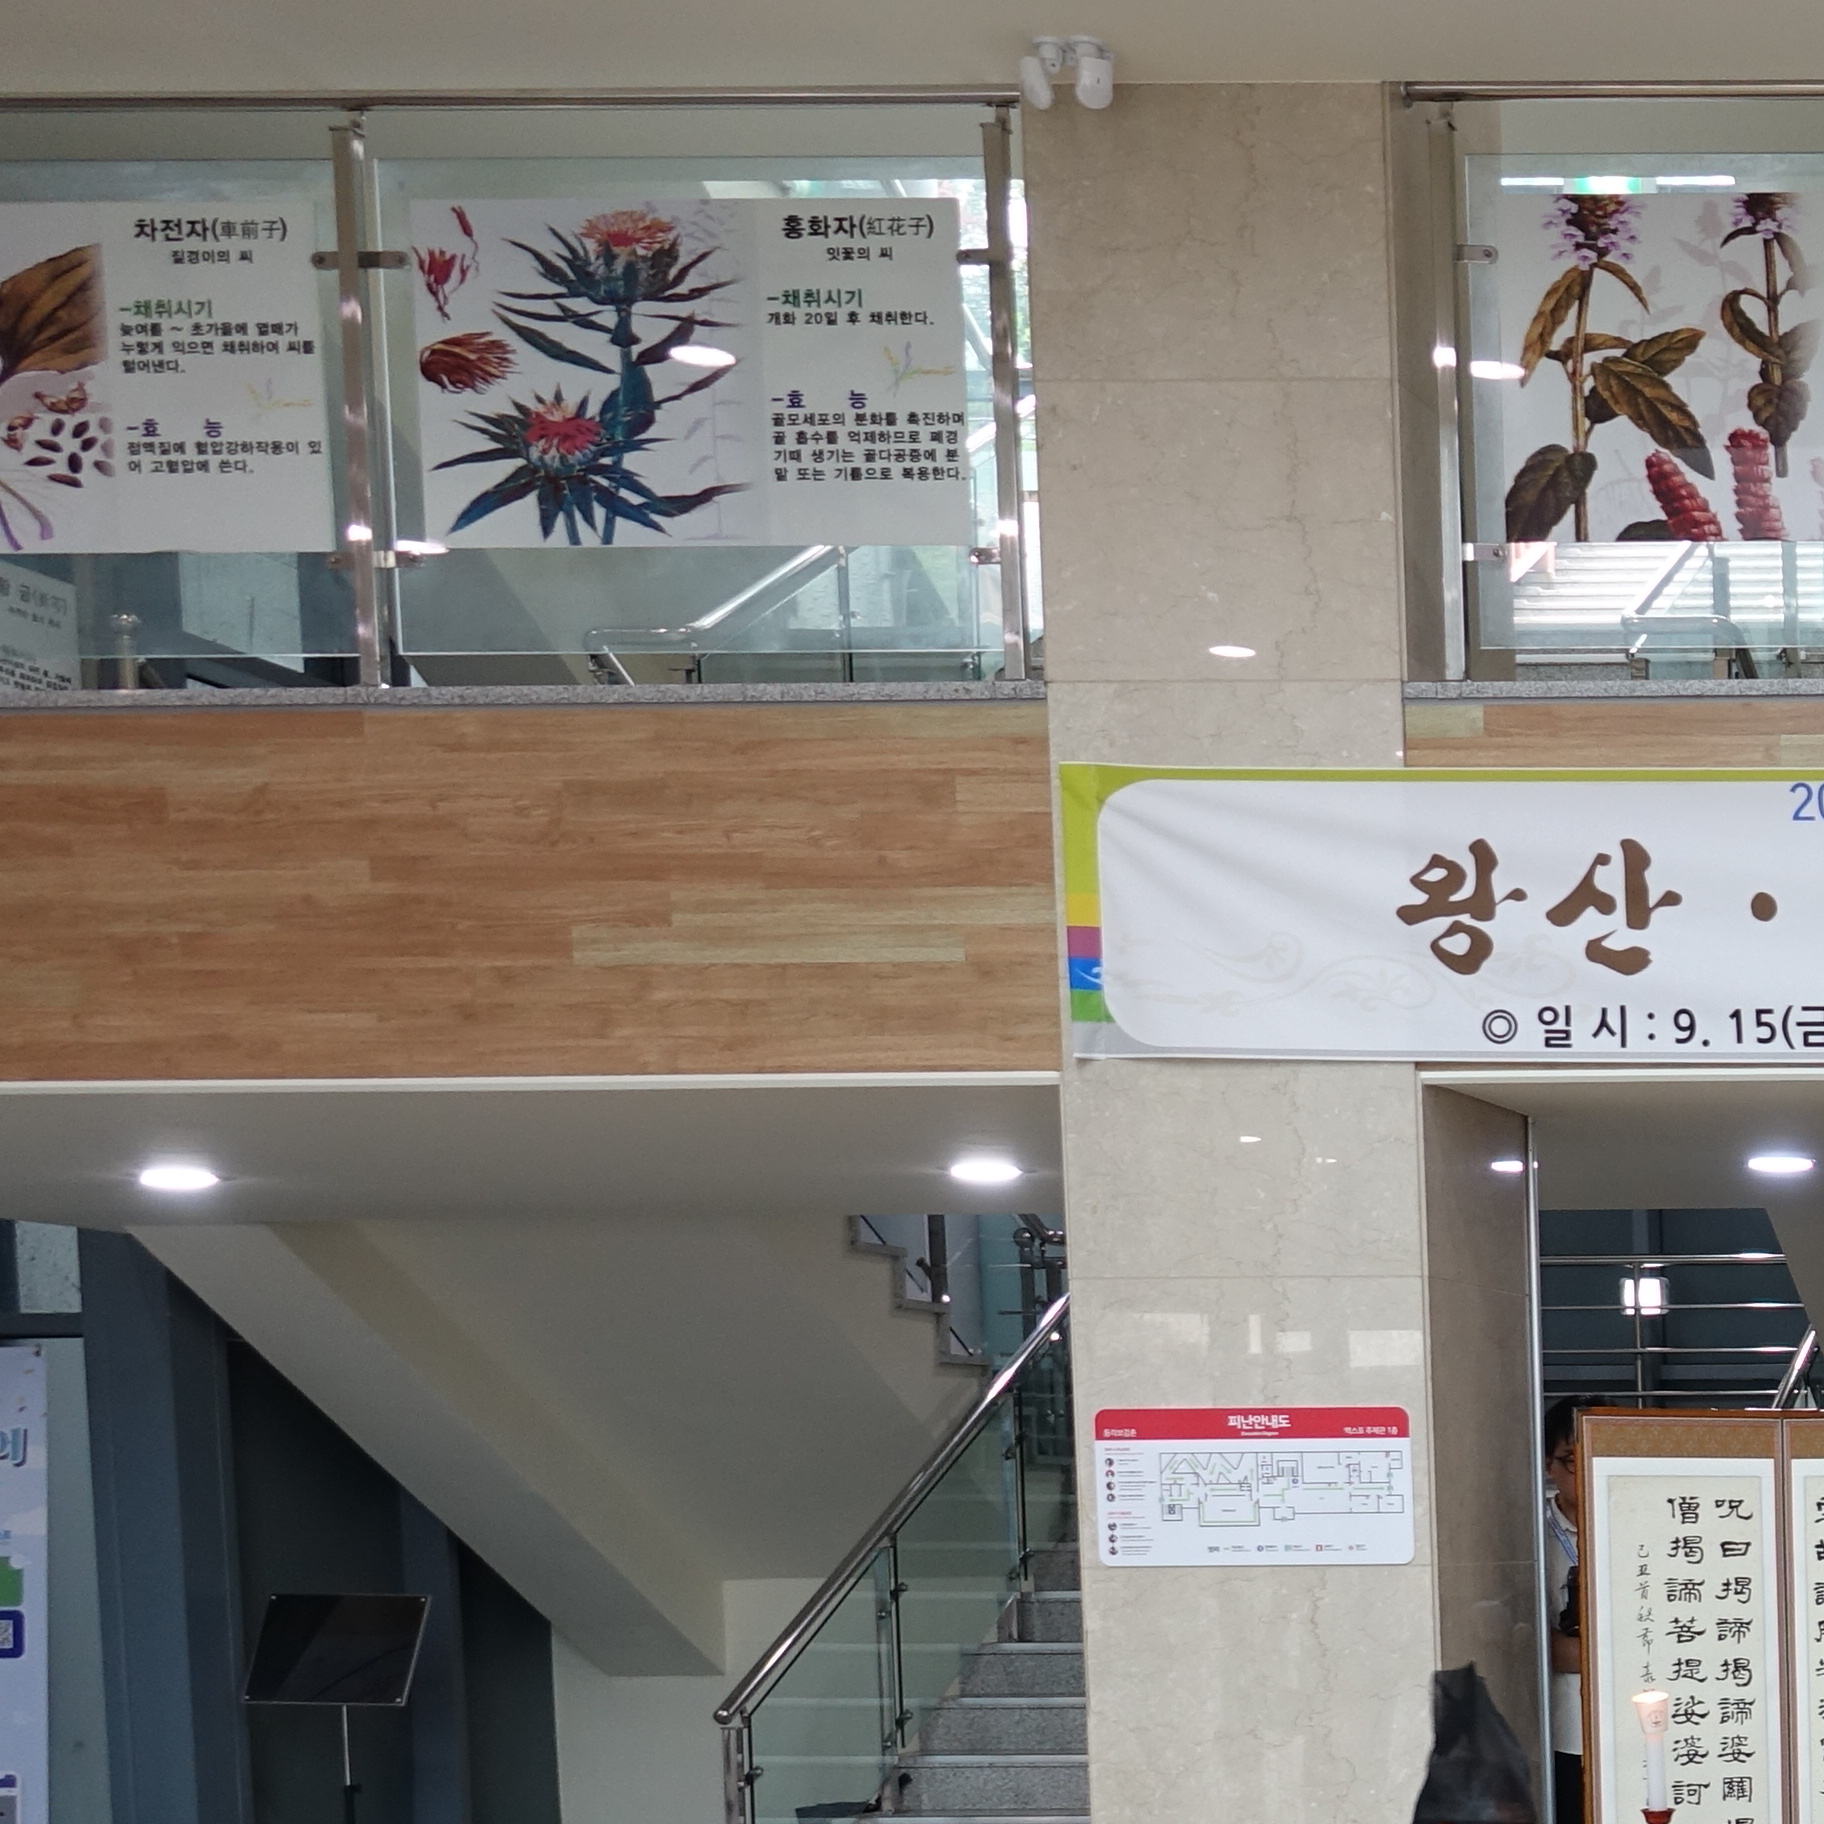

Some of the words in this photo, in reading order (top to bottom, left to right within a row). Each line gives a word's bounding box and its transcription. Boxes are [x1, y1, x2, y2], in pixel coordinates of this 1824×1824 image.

[782, 214, 934, 239] 홍화자(紅花子)
[805, 311, 837, 325] 20일
[1396, 838, 1682, 976] 왕산
[1228, 1414, 1291, 1429] 피난안내도
